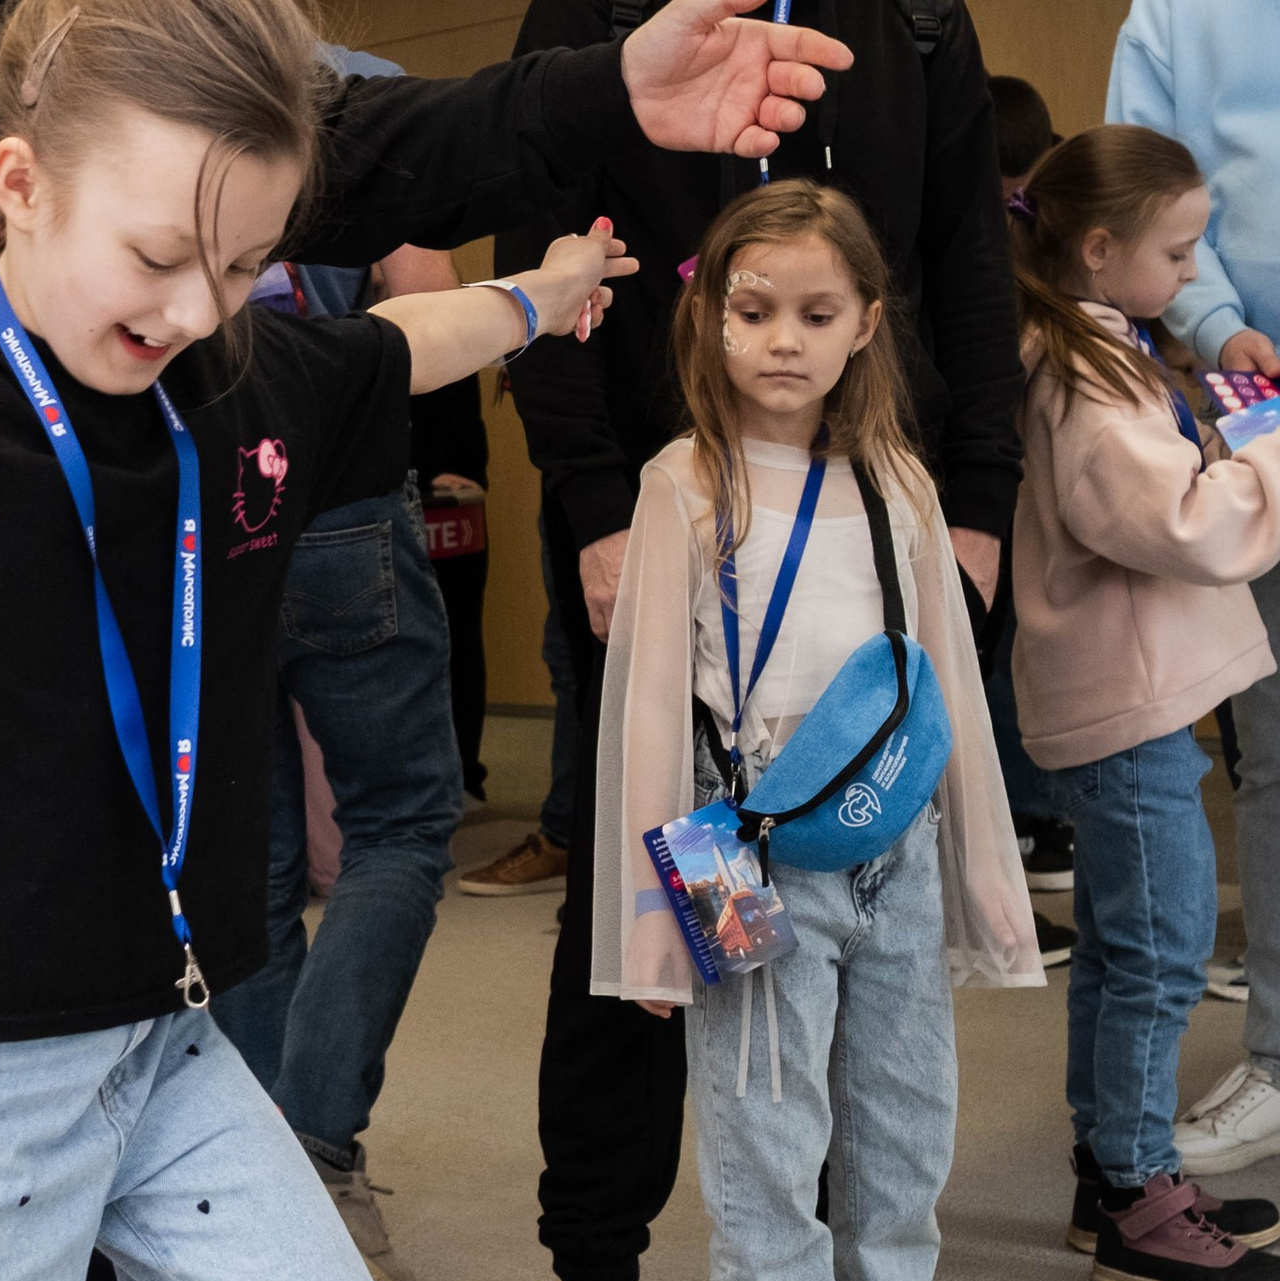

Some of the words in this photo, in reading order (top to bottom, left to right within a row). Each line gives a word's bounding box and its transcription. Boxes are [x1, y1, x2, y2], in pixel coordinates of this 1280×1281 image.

[50, 423, 67, 437] Я
[184, 519, 196, 532] Я
[177, 739, 191, 753] Я
